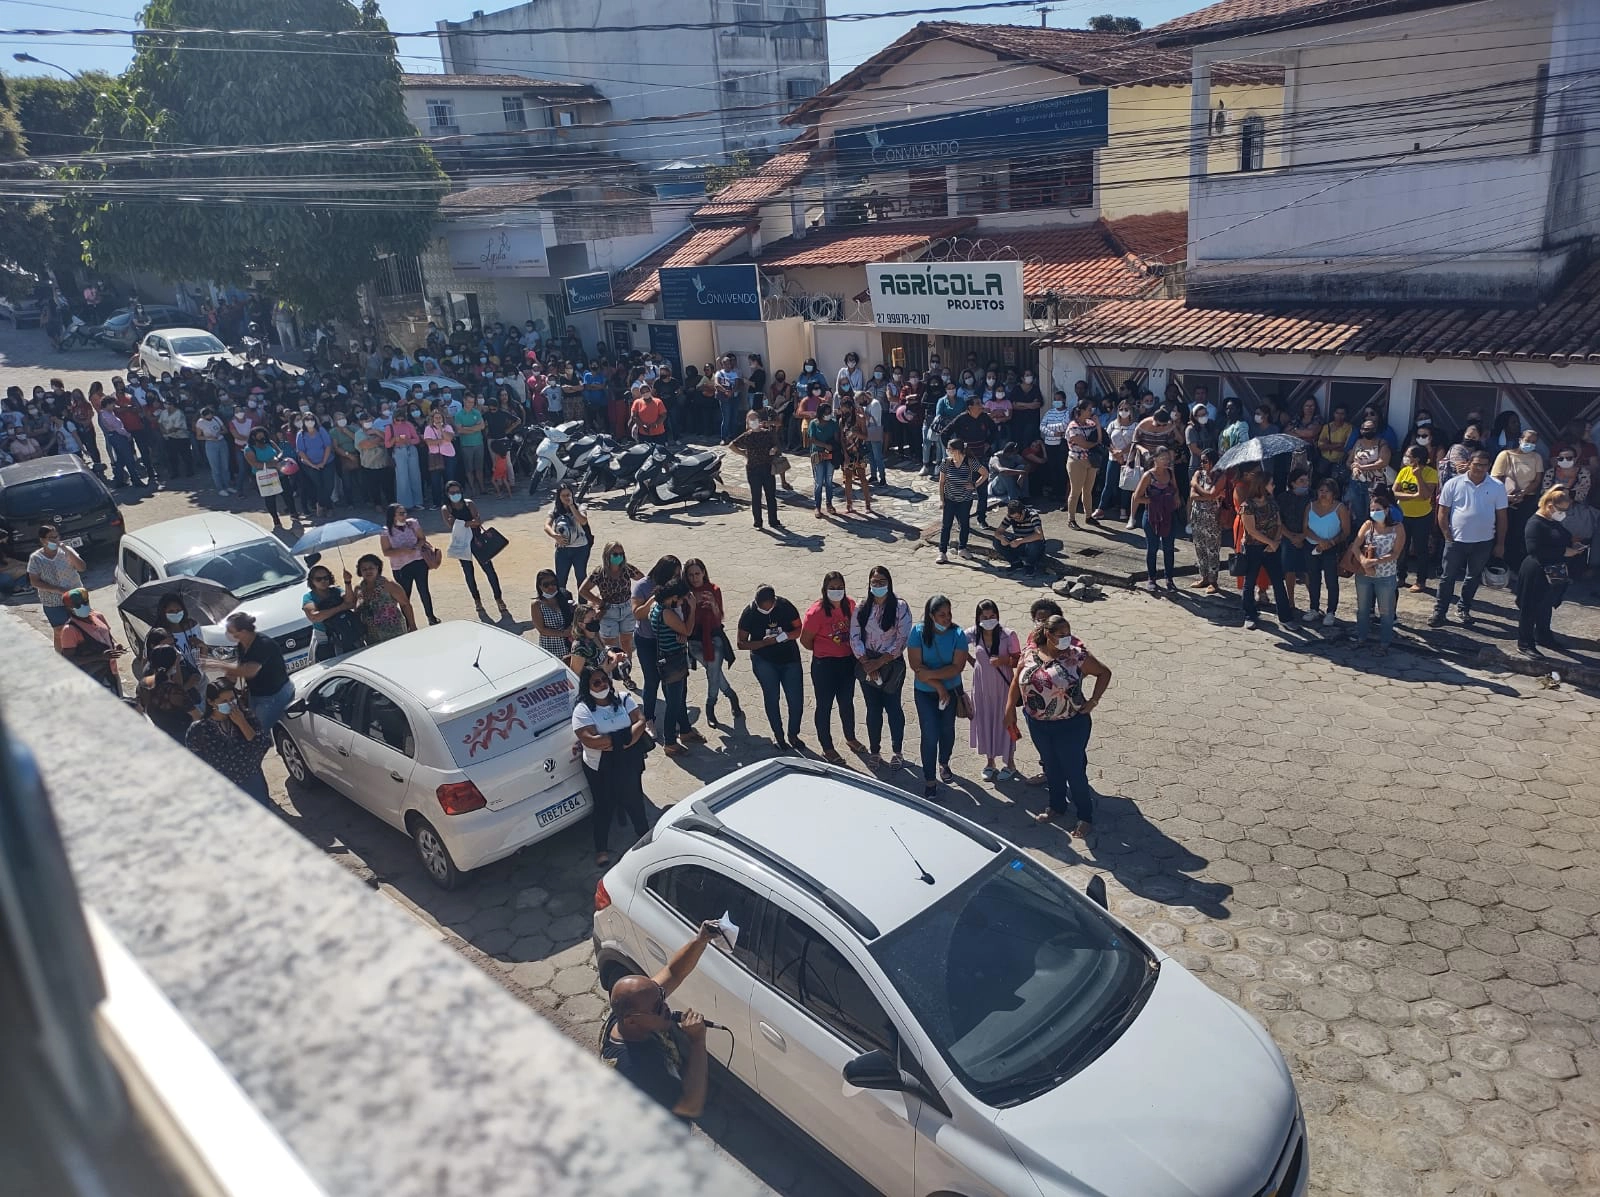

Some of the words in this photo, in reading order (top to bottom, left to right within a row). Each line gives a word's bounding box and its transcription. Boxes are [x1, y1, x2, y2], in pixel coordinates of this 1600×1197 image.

[872, 140, 960, 164] CONVIVENDO
[879, 265, 1004, 296] AGRÍCOLA
[696, 290, 758, 305] CONVIVENDO
[947, 299, 1005, 311] PROJETOS
[876, 313, 885, 324] 27
[1151, 368, 1164, 378] 77
[516, 678, 575, 709] SINDSERV
